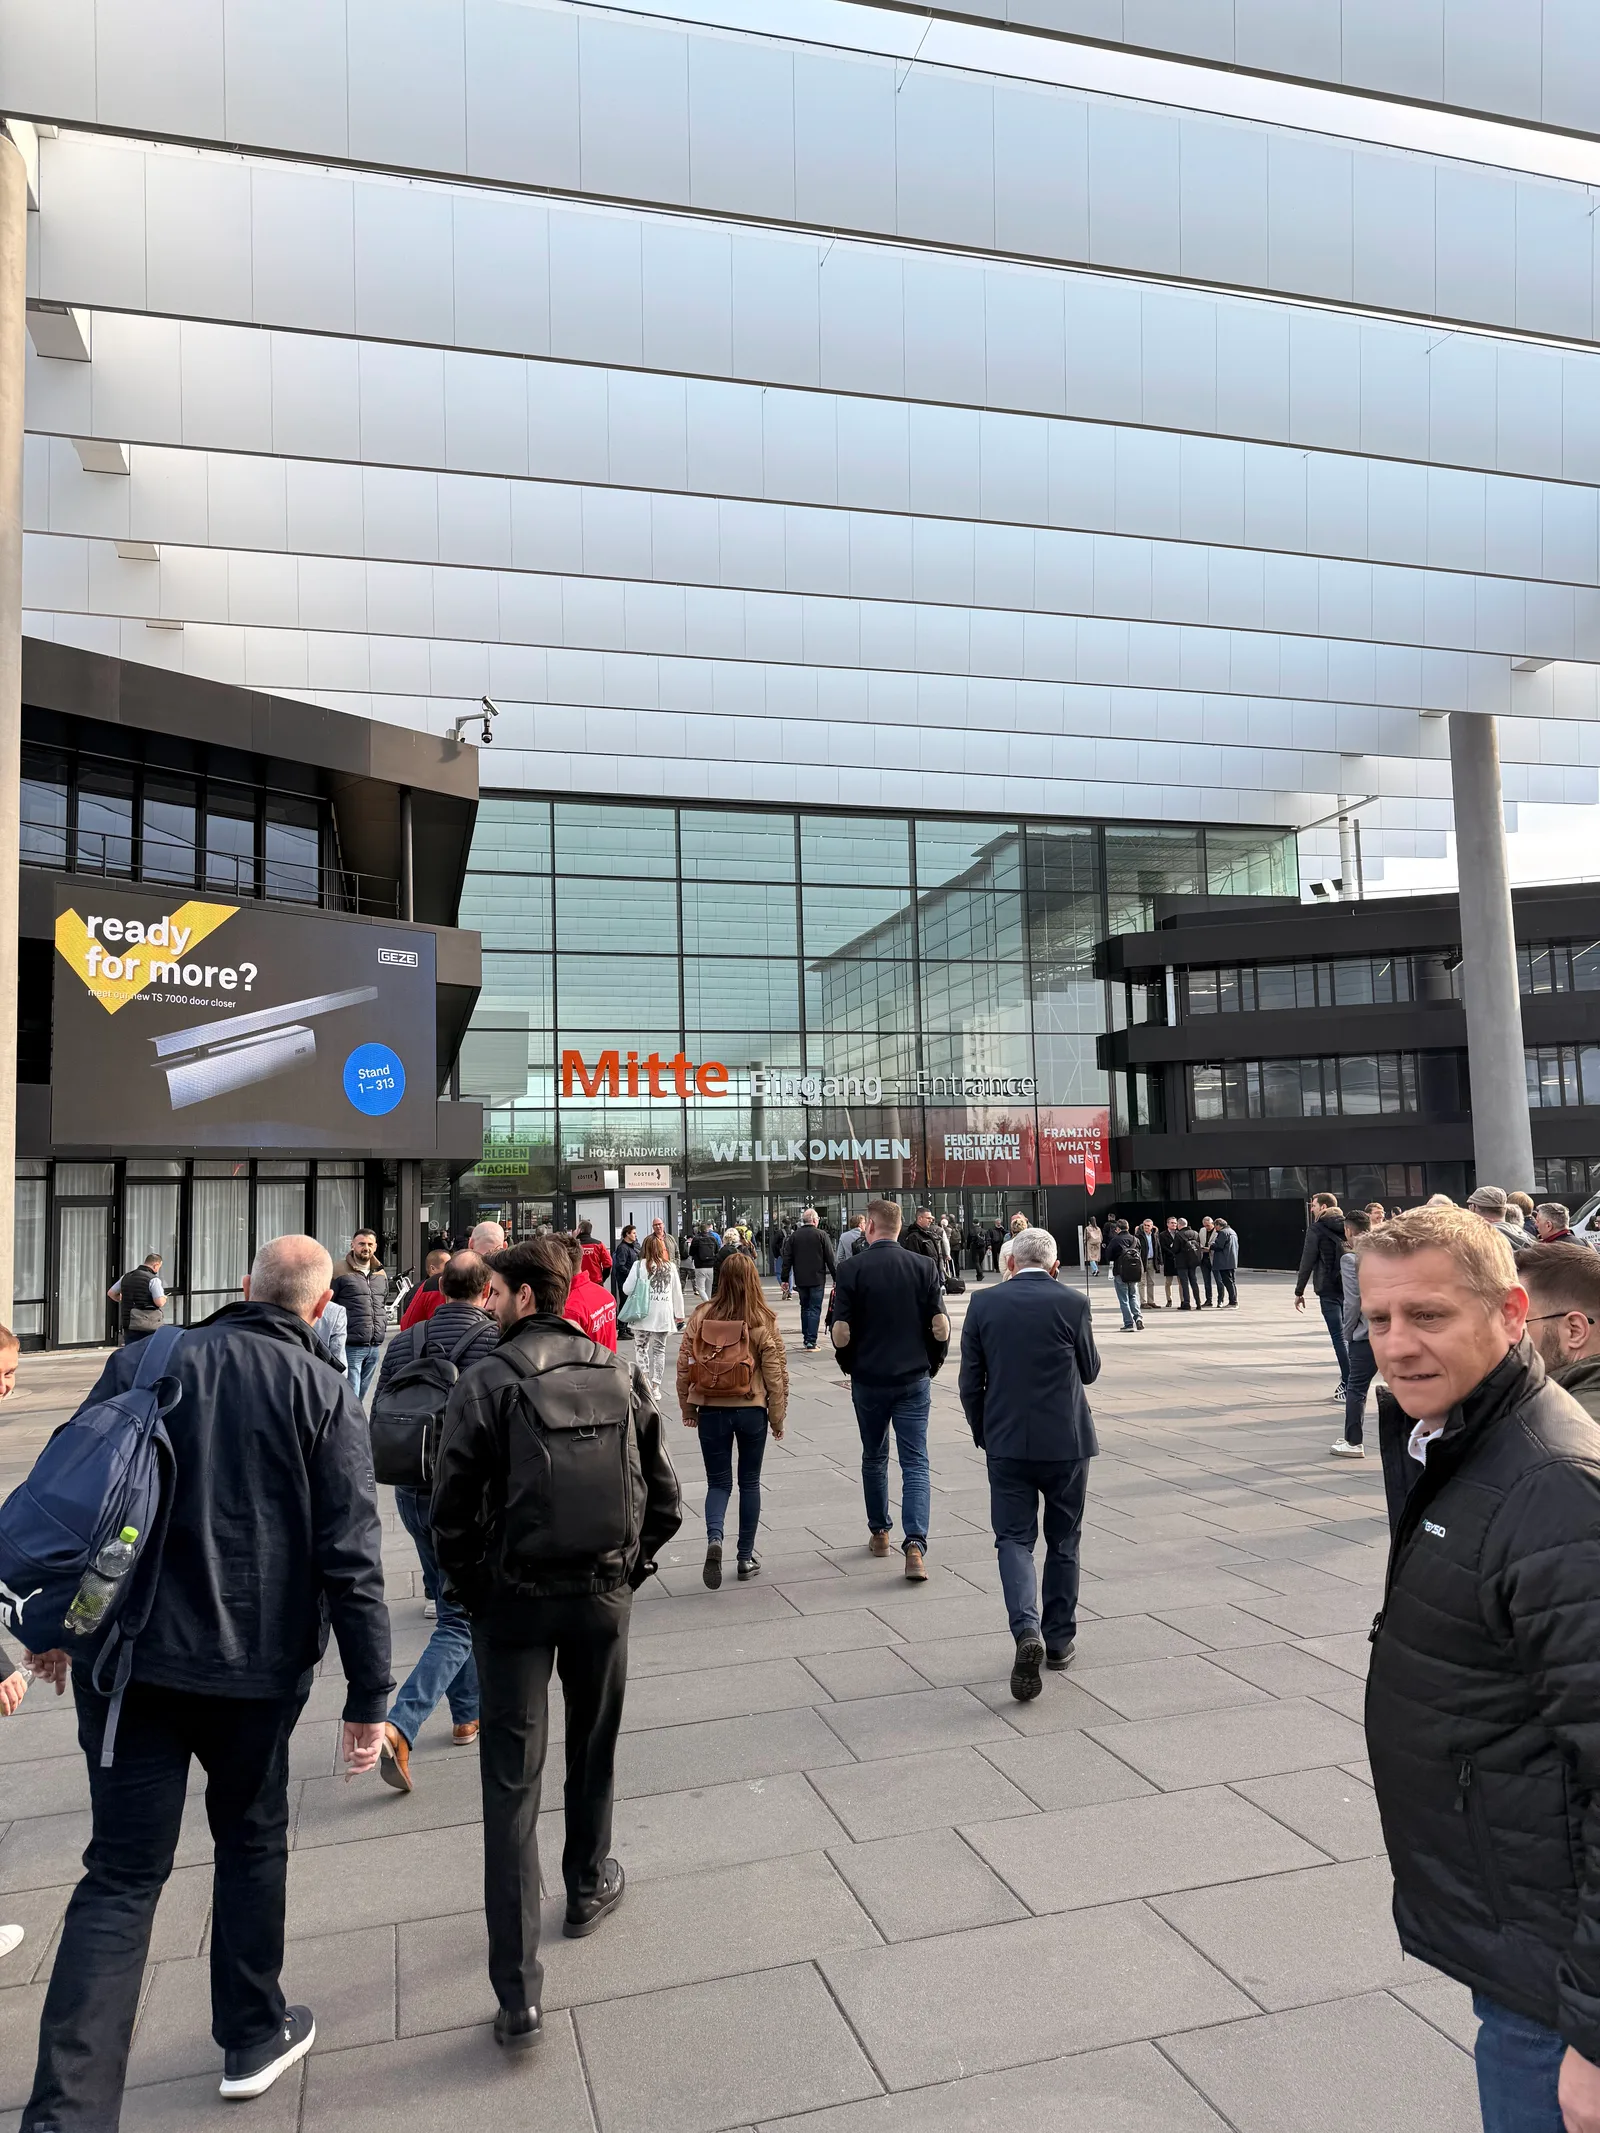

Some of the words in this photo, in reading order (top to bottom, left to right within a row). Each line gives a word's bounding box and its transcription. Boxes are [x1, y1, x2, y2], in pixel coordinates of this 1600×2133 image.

[87, 915, 191, 956] ready
[380, 951, 416, 965] GEZE
[85, 946, 140, 981] for
[150, 961, 258, 992] more?
[88, 988, 111, 998] meet
[131, 993, 150, 1001] new
[151, 993, 163, 1002] TS
[165, 994, 188, 1004] 7000
[189, 996, 209, 1006] door
[210, 998, 236, 1009] closer
[358, 1064, 390, 1080] Stand
[562, 1050, 729, 1098] Mitte
[750, 1070, 882, 1106] Eingang
[916, 1070, 1036, 1097] Entrance
[1043, 1127, 1101, 1138] FRAMING
[944, 1133, 1020, 1147] FENSTERBAU
[1056, 1140, 1102, 1151] WHAT'S
[484, 1148, 527, 1159] RLEBEN
[589, 1147, 678, 1158] HOLZ-HANDWERK
[709, 1138, 911, 1162] WILLKOMMEN
[1068, 1153, 1103, 1164] NET.
[477, 1163, 527, 1175] MACHEN
